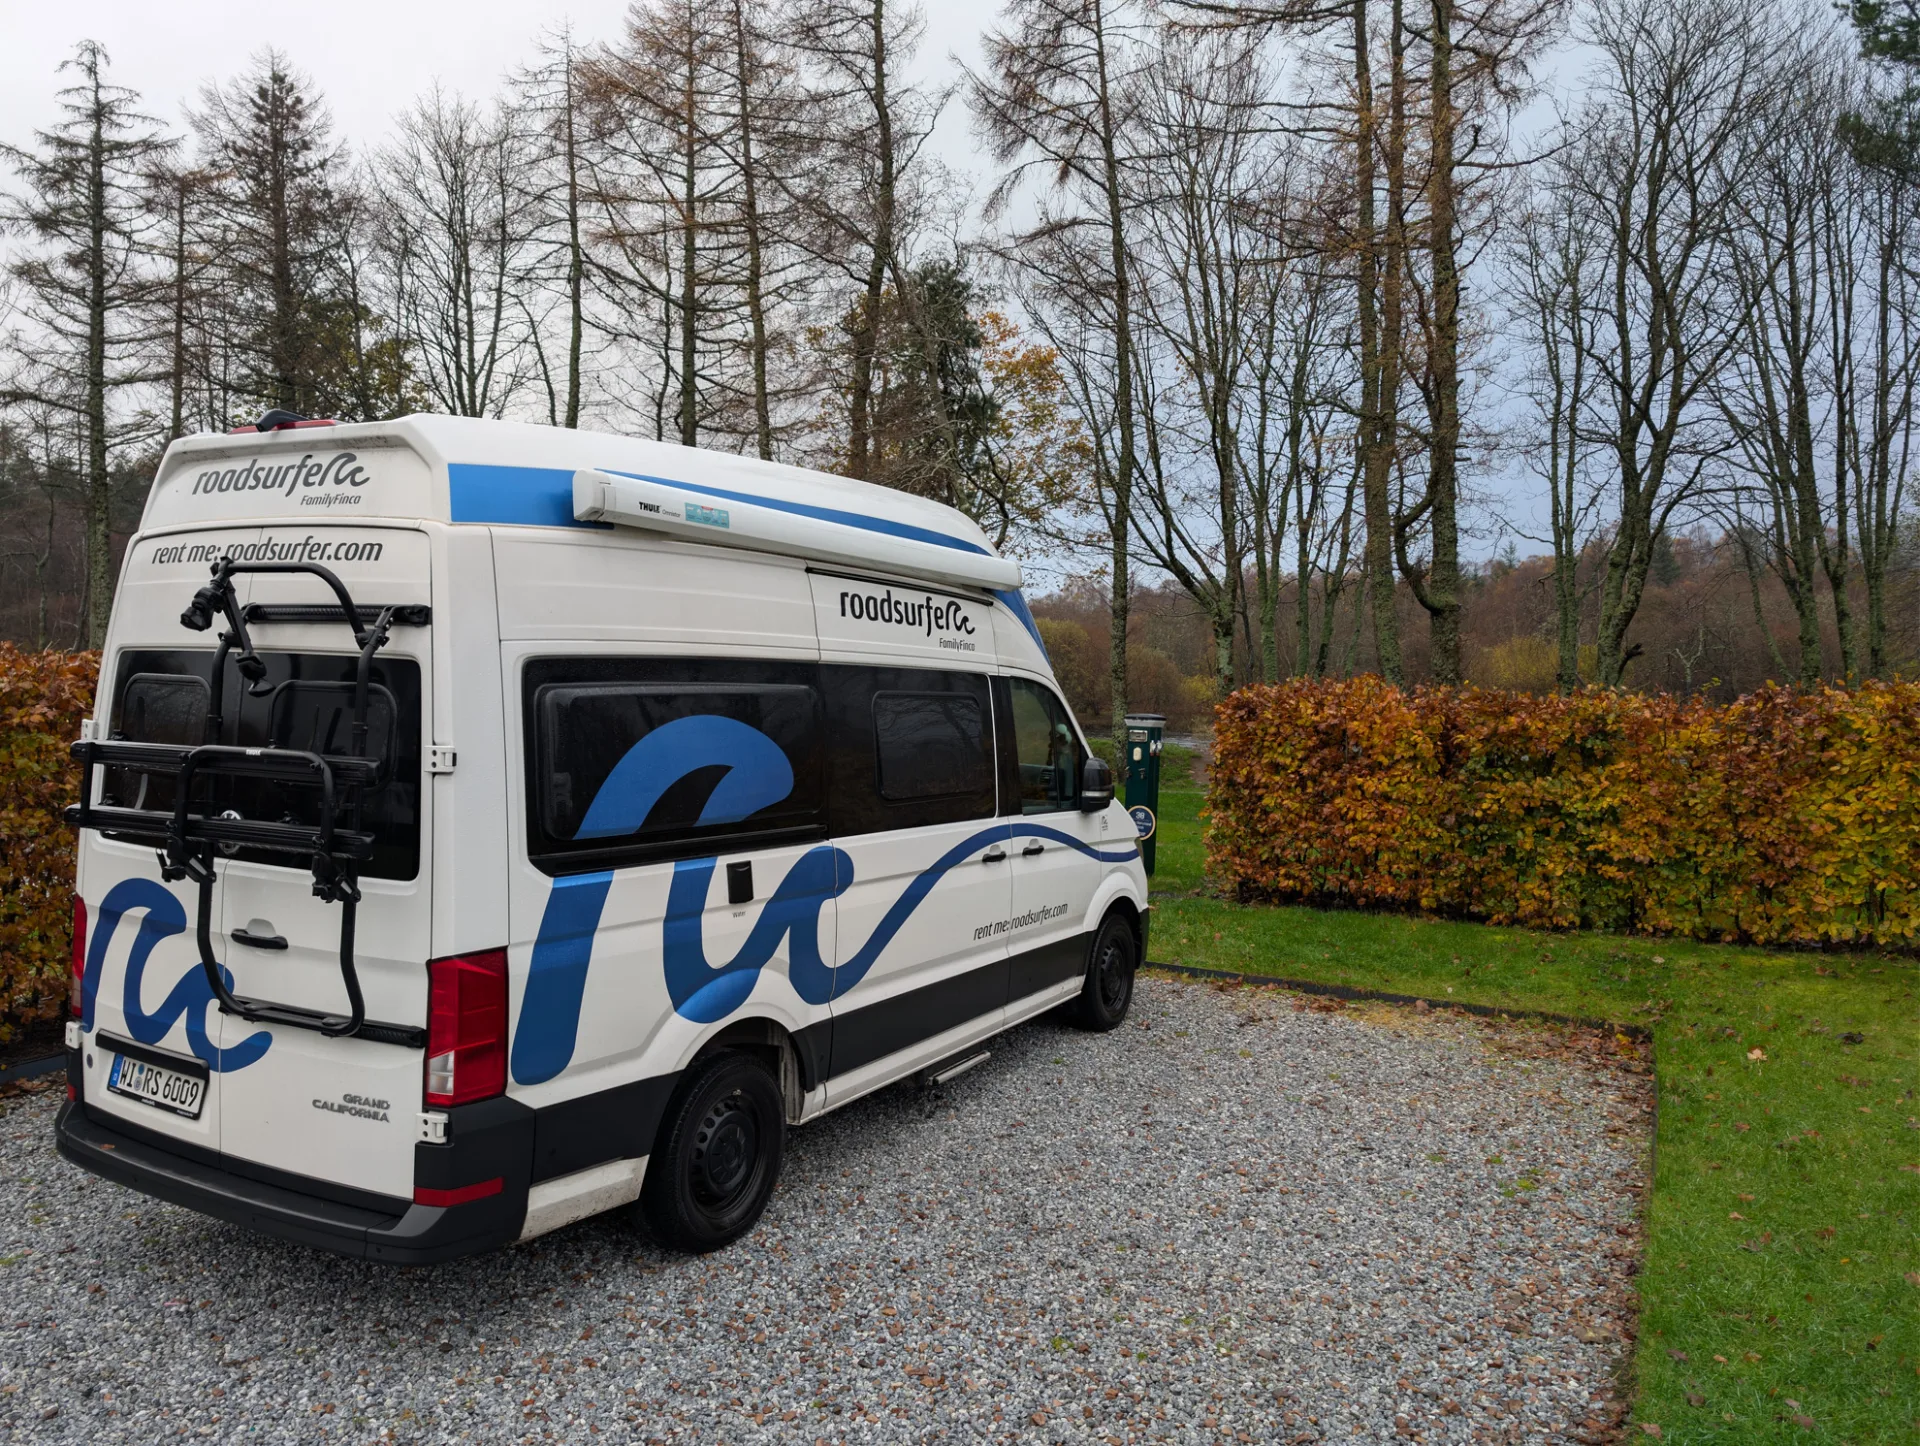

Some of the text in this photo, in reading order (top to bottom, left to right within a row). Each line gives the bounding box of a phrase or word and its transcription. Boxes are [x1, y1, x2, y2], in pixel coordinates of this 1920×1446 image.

[192, 453, 370, 498] roadsurfer
[300, 493, 362, 508] FamilyFinca
[639, 501, 661, 514] THULE
[662, 509, 682, 518] Omnistor
[152, 535, 383, 565] rent me: roadsurfer.com
[840, 590, 975, 637] roadsurfer
[939, 638, 976, 652] FamilyFinca
[973, 903, 1069, 940] rent me: roadsurfer.com
[120, 1060, 199, 1108] WI RS 6009
[312, 1099, 390, 1123] CALIFORNIA
[343, 1093, 391, 1110] GRAND
